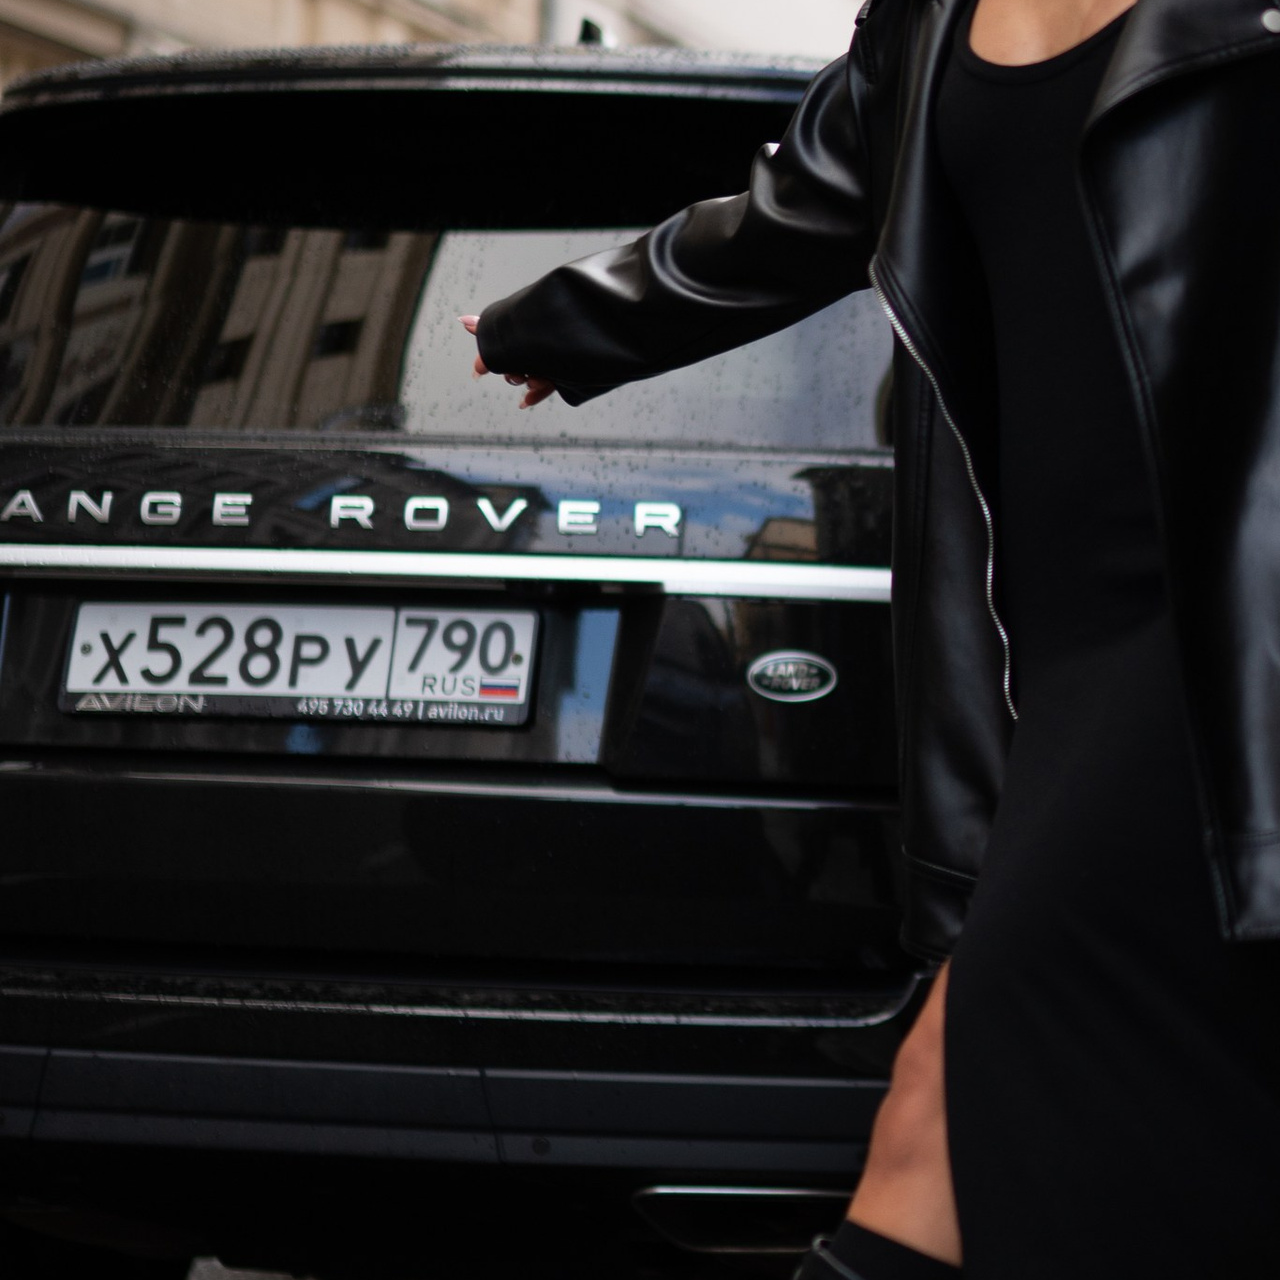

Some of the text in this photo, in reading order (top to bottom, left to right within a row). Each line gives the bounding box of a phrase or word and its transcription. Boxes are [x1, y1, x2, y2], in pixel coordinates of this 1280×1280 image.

[329, 494, 683, 538] ROVER
[404, 617, 516, 676] 790
[421, 674, 476, 697] RUS
[298, 698, 329, 716] 495
[333, 699, 364, 717] 730
[392, 701, 414, 718] 49
[427, 702, 505, 722] avilon.ru
